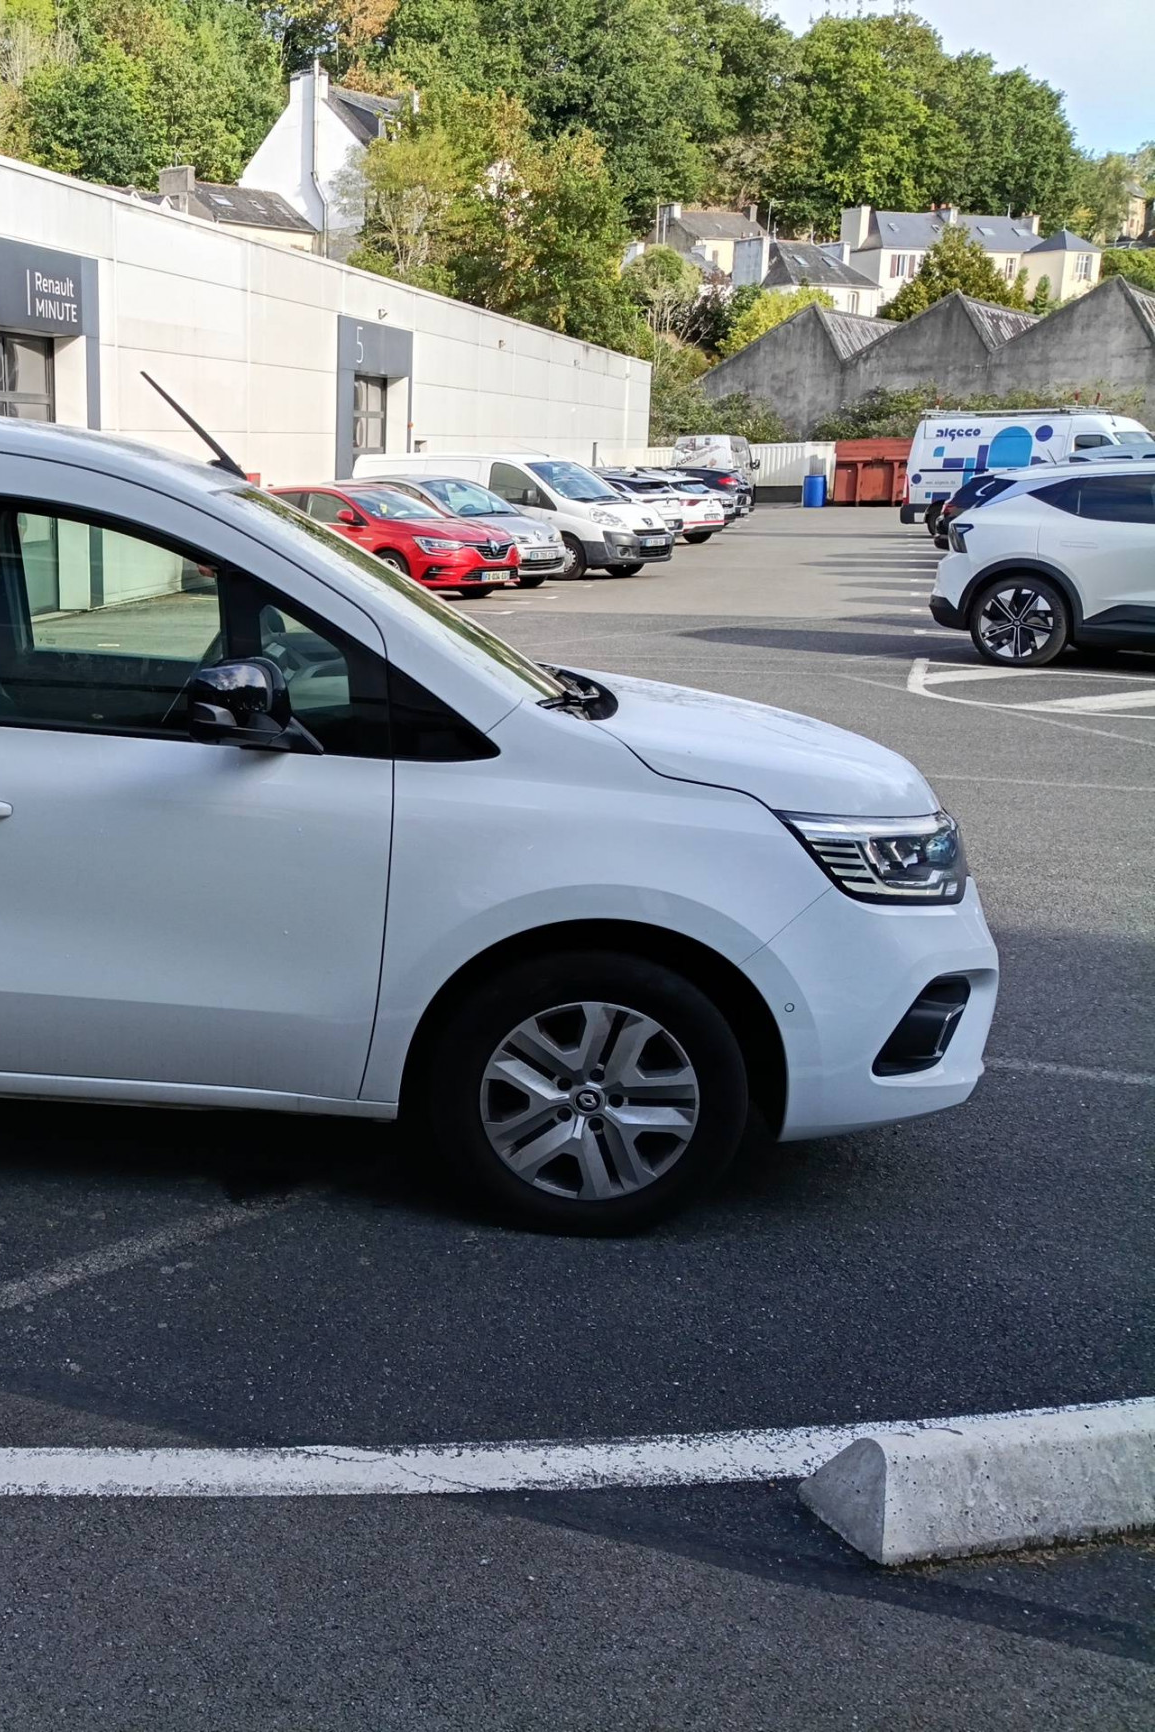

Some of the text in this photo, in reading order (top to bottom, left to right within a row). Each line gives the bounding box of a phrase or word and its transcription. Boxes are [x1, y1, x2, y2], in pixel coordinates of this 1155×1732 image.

[34, 271, 75, 298] Renault
[35, 298, 78, 323] MINUTE
[356, 326, 364, 363] 5
[936, 427, 981, 442] algeco
